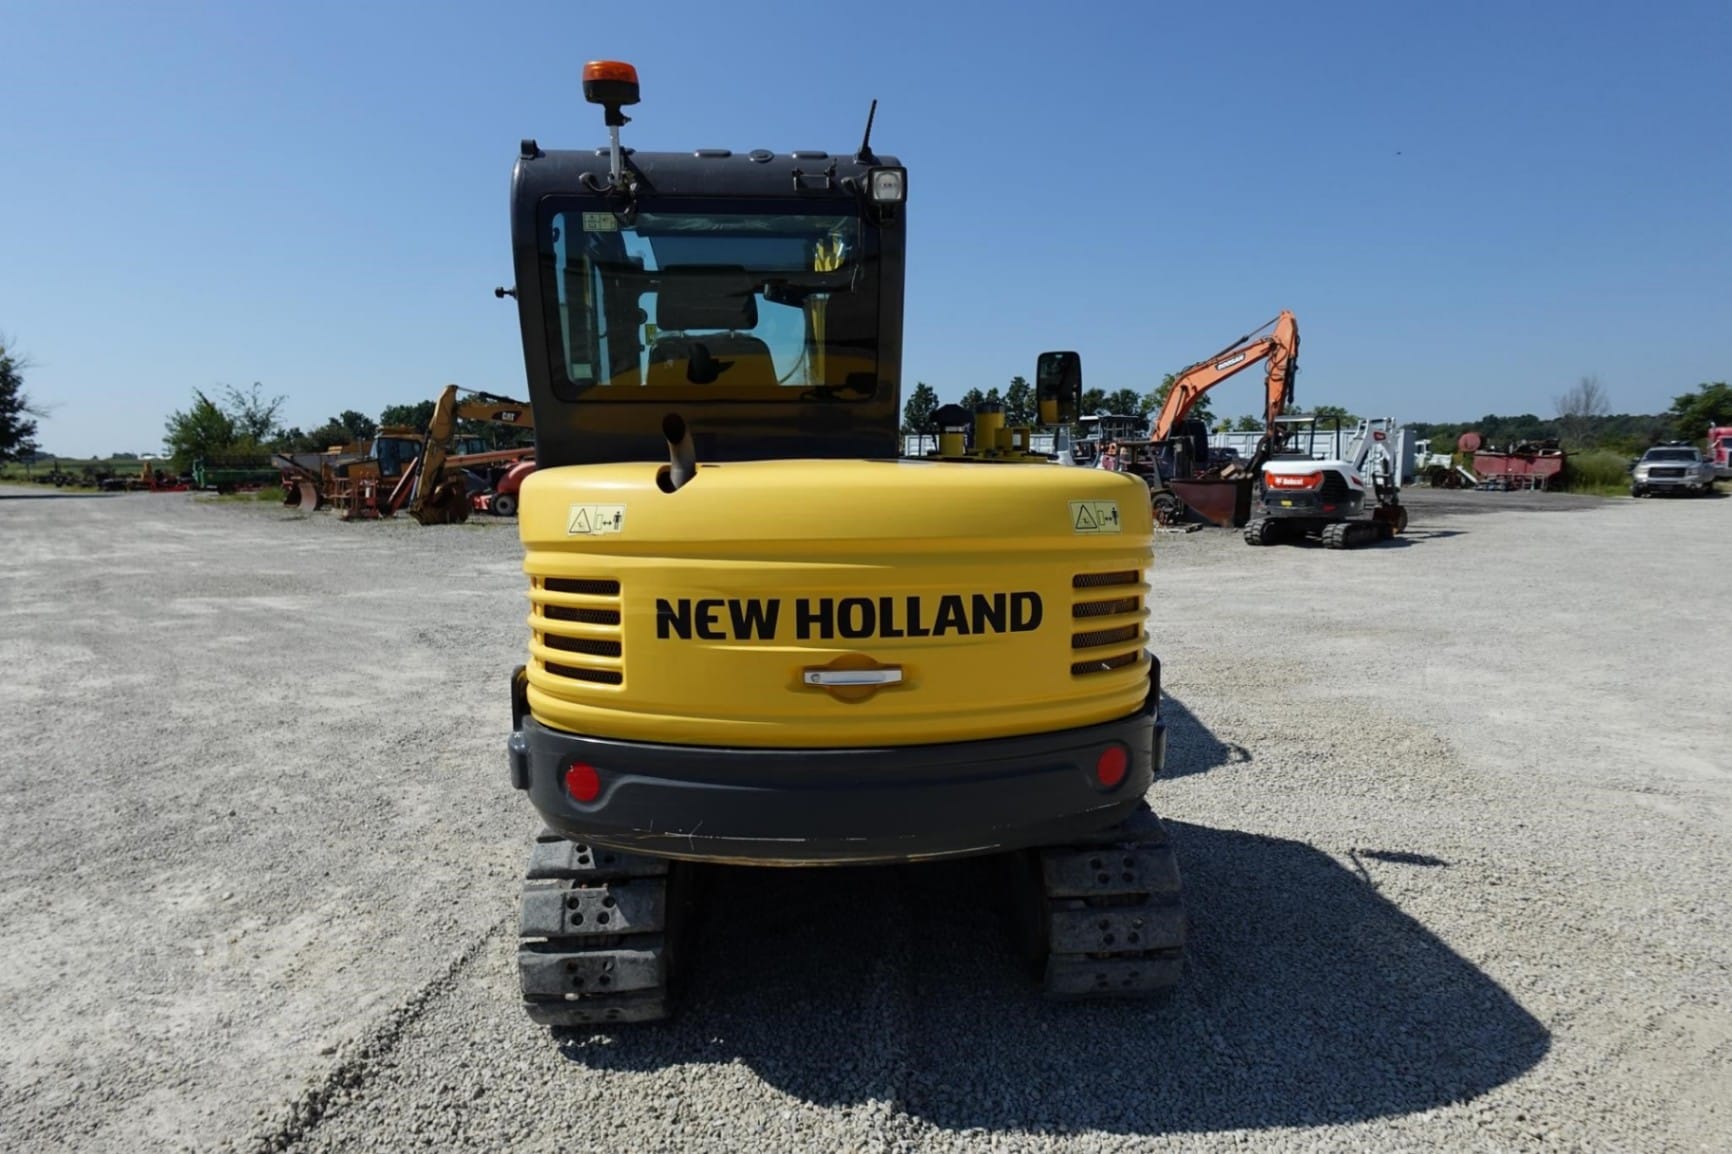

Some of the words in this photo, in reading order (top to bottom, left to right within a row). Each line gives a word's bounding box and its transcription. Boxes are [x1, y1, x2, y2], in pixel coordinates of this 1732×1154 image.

[502, 411, 516, 422] CAT
[656, 598, 780, 640] NEW
[796, 591, 1043, 639] HOLLAND
